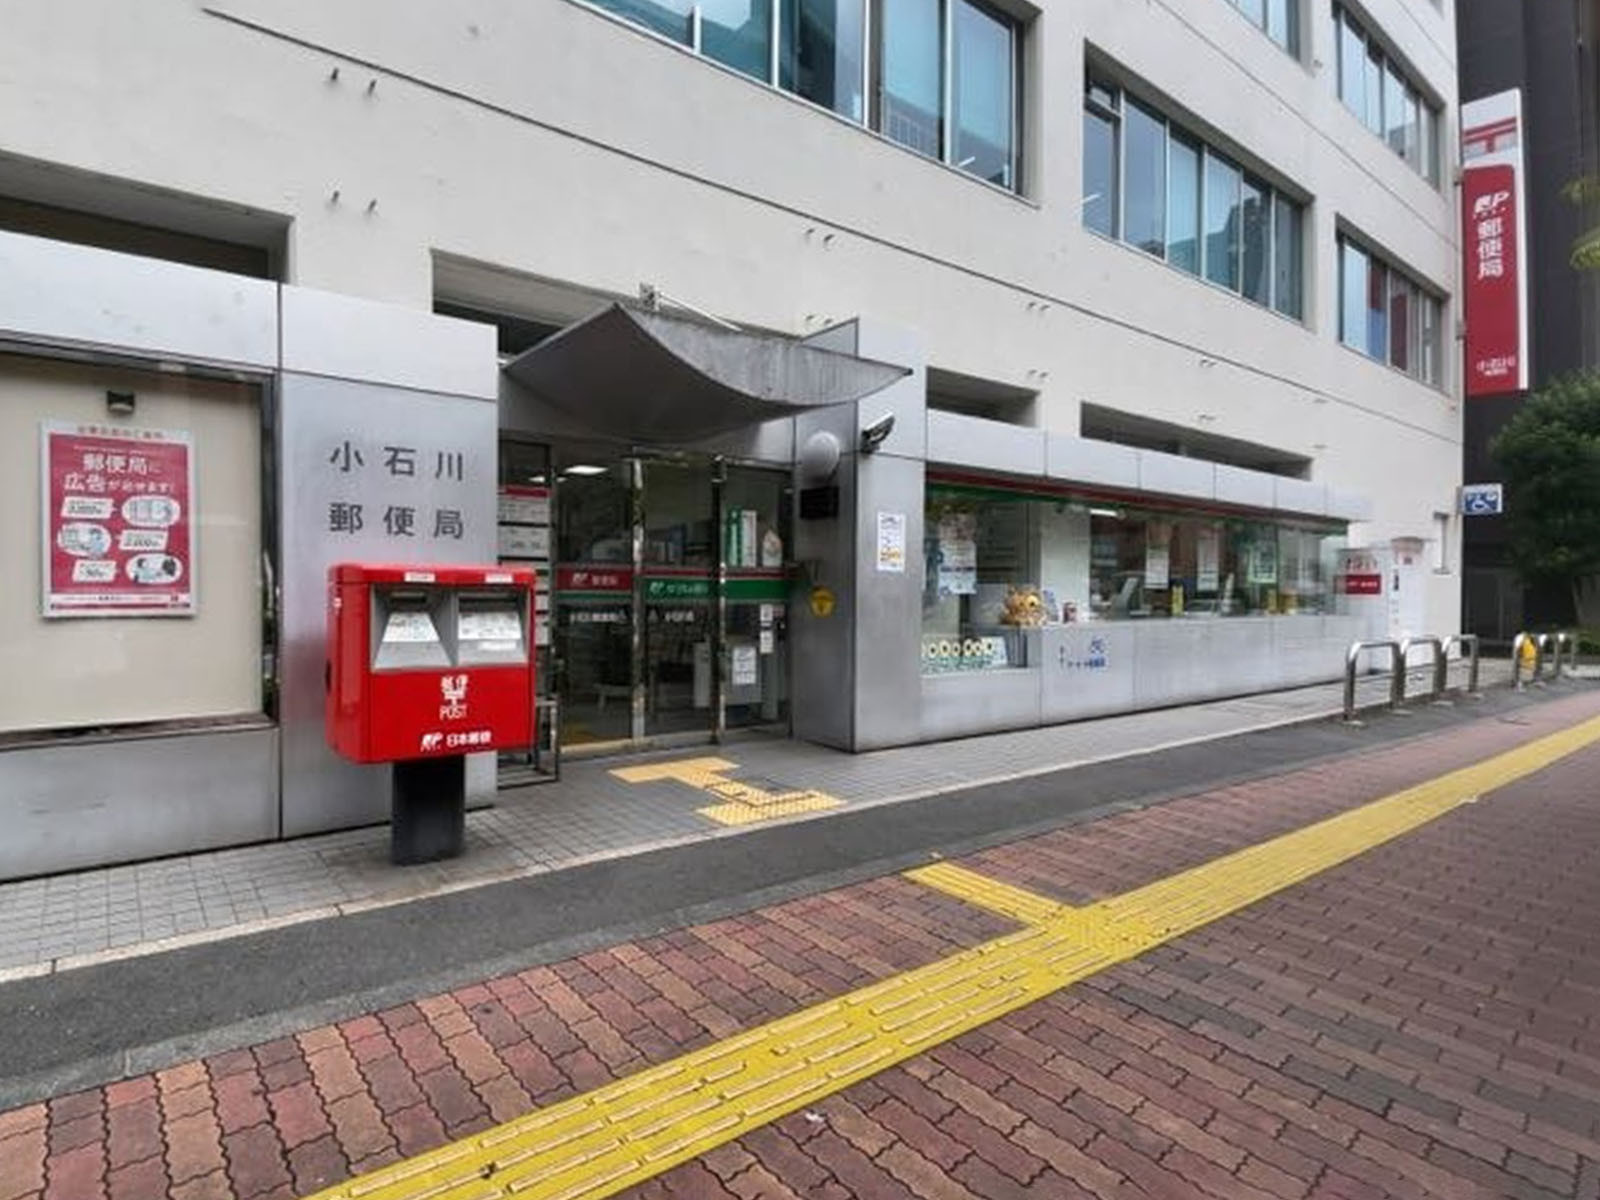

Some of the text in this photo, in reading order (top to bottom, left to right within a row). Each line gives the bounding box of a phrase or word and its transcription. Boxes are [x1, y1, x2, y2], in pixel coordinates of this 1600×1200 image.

[1478, 218, 1503, 279] 郵便局
[330, 441, 464, 480] 小石川
[330, 503, 464, 538] 郵便局
[440, 705, 467, 720] POST
